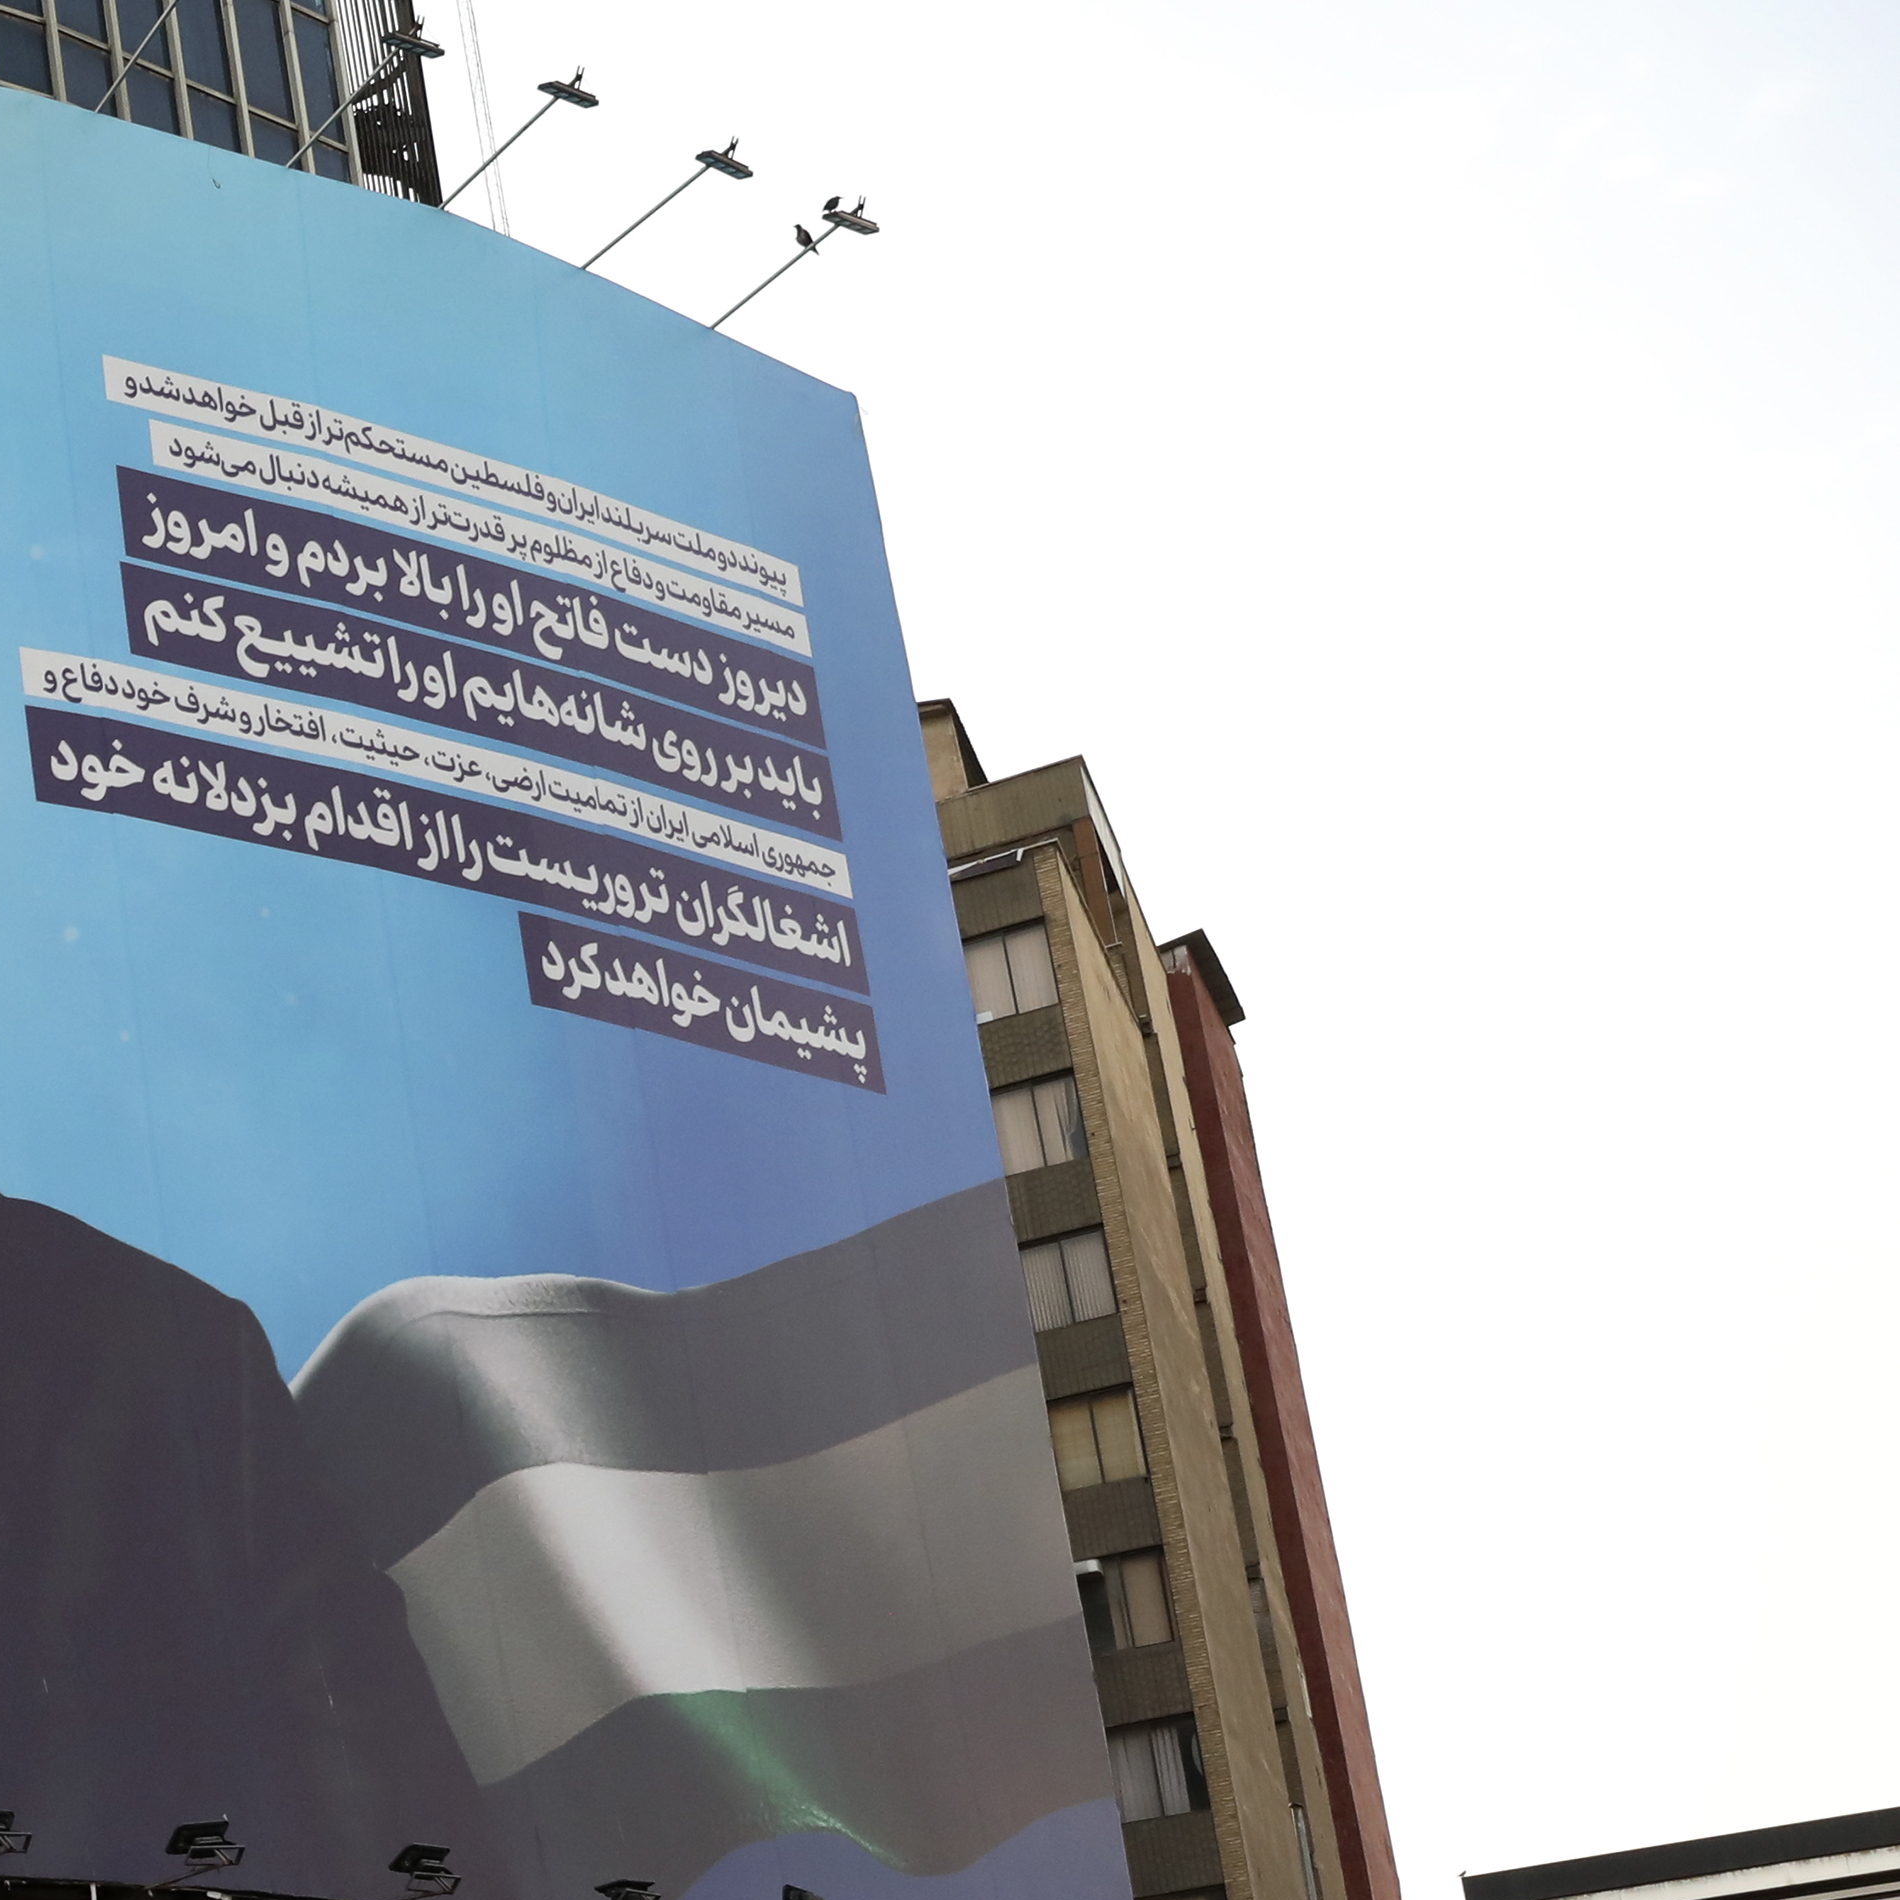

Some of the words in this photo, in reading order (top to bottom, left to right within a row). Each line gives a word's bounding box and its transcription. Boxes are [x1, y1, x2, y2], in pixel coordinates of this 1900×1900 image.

[124, 377, 137, 398] و
[140, 377, 180, 401] شد
[183, 387, 256, 422] خواهد
[260, 405, 304, 434] قبل
[306, 409, 322, 441] از
[260, 454, 319, 491] دنبال
[451, 464, 544, 501] فلسطین
[322, 475, 408, 515] همیشه
[410, 495, 425, 525] از
[546, 490, 556, 513] و
[558, 493, 599, 524] ایران
[142, 493, 257, 559] امروز
[506, 532, 526, 558] پر
[602, 507, 671, 545] سربلند
[265, 534, 289, 577] و
[530, 535, 592, 568] مظلوم
[594, 550, 607, 579] از
[673, 533, 716, 561] ملت
[718, 551, 737, 571] دو
[297, 540, 387, 602] بردم
[393, 549, 452, 619] بالا
[610, 558, 652, 589] دفاع
[654, 580, 665, 599] و
[739, 556, 787, 597] پیوند
[456, 563, 486, 627] را
[492, 580, 523, 635] او
[667, 581, 741, 620] مقاومت
[144, 593, 226, 646] کنم
[529, 595, 609, 659] فاتح
[743, 612, 794, 639] مسیر
[234, 616, 384, 678] تشییع
[615, 623, 712, 684] دست
[43, 670, 57, 693] و
[62, 663, 118, 703] دفاع
[387, 636, 418, 702] را
[423, 651, 456, 709] او
[718, 654, 806, 721] دیروز
[122, 680, 170, 711] خود
[175, 686, 236, 724] شرف
[239, 711, 252, 734] و
[254, 704, 326, 741] افتخار
[50, 739, 146, 801] خود
[653, 730, 717, 786] روی
[721, 755, 753, 798] بر
[152, 756, 296, 841] بزدلانه
[549, 781, 627, 816] تمامیت
[758, 756, 822, 819] باید
[305, 786, 413, 850] اقدام
[630, 797, 643, 828] از
[647, 804, 689, 842] ایران
[418, 810, 449, 870] از
[451, 814, 482, 881] را
[692, 825, 759, 857] اسلامی
[487, 835, 669, 923] تروریست
[762, 847, 835, 886] جمهوری
[676, 881, 851, 966] اشغالگران
[542, 941, 601, 999] کرد
[605, 958, 720, 1027] خواهد
[726, 986, 867, 1083] پشیمان
